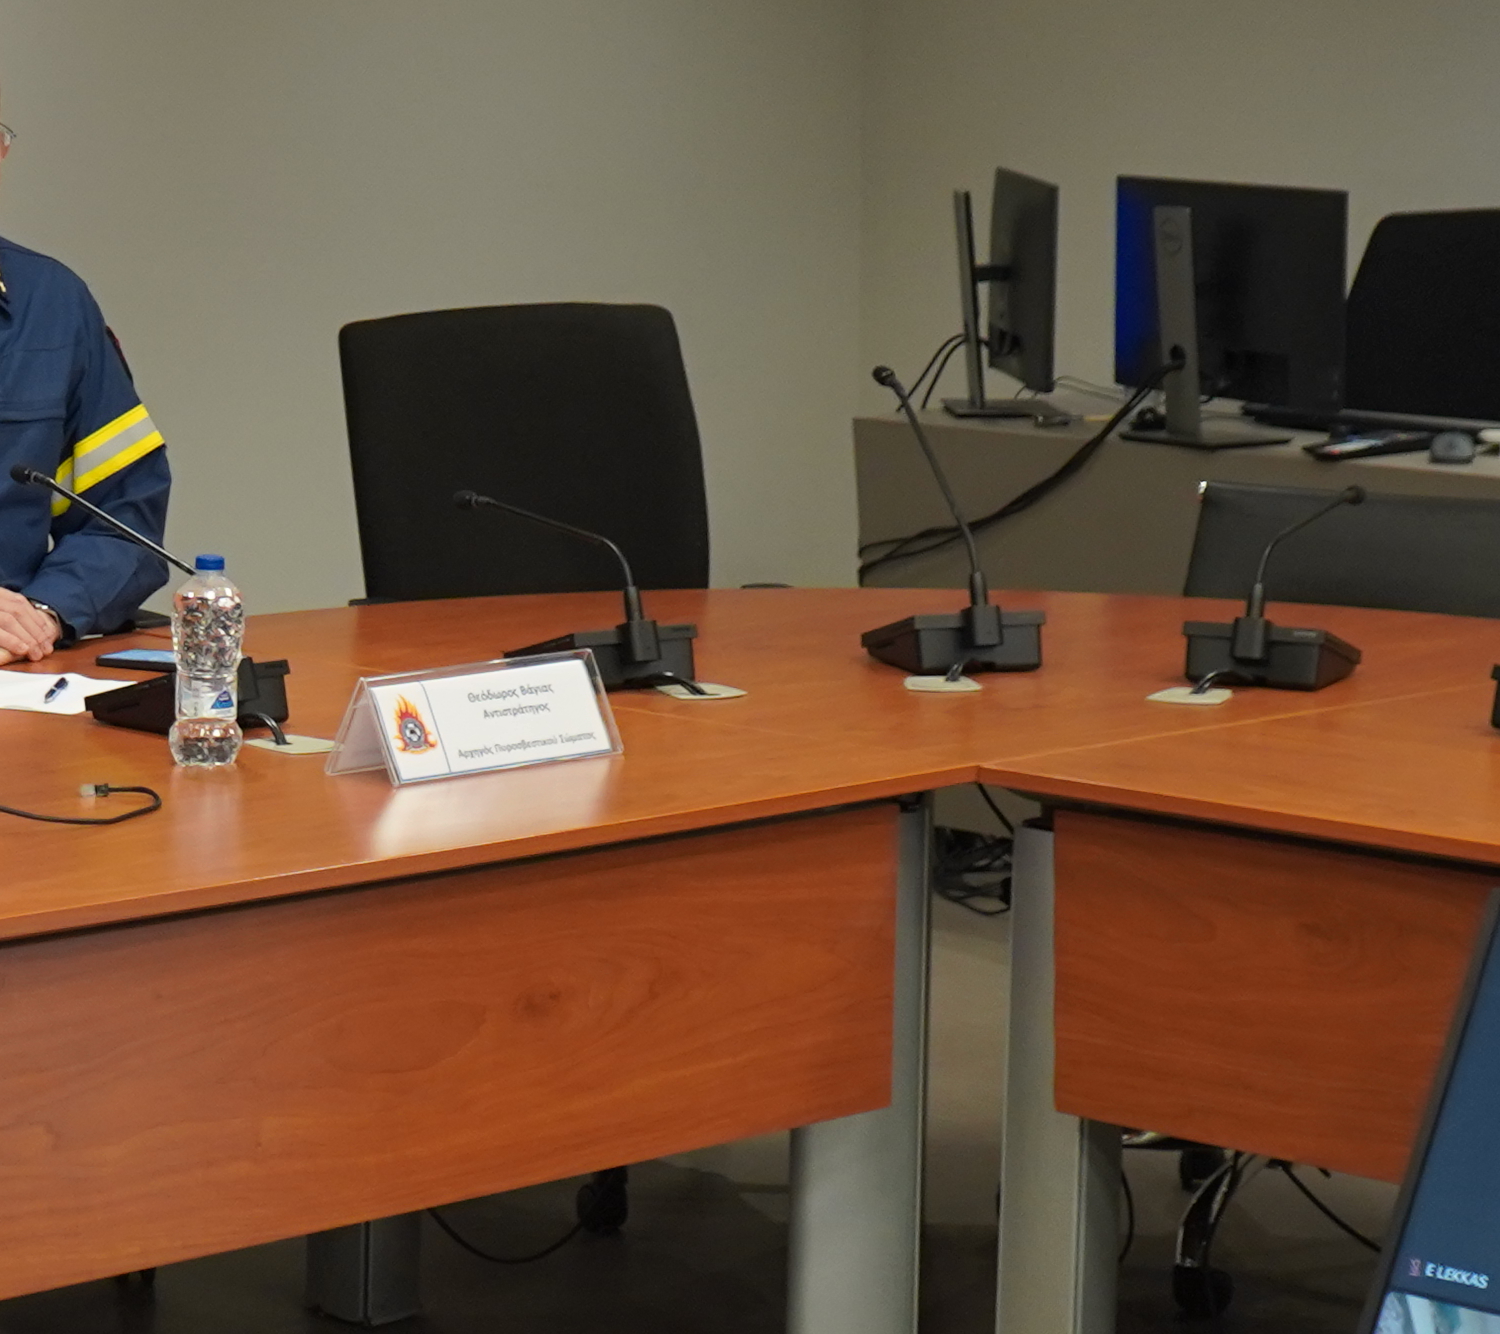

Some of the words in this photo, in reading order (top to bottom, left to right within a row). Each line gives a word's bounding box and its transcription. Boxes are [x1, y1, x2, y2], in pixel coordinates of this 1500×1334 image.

[467, 687, 519, 703] Θεόδωρος
[482, 701, 551, 719] Αντιστράτηγος
[1436, 1263, 1490, 1289] LEKKAS
